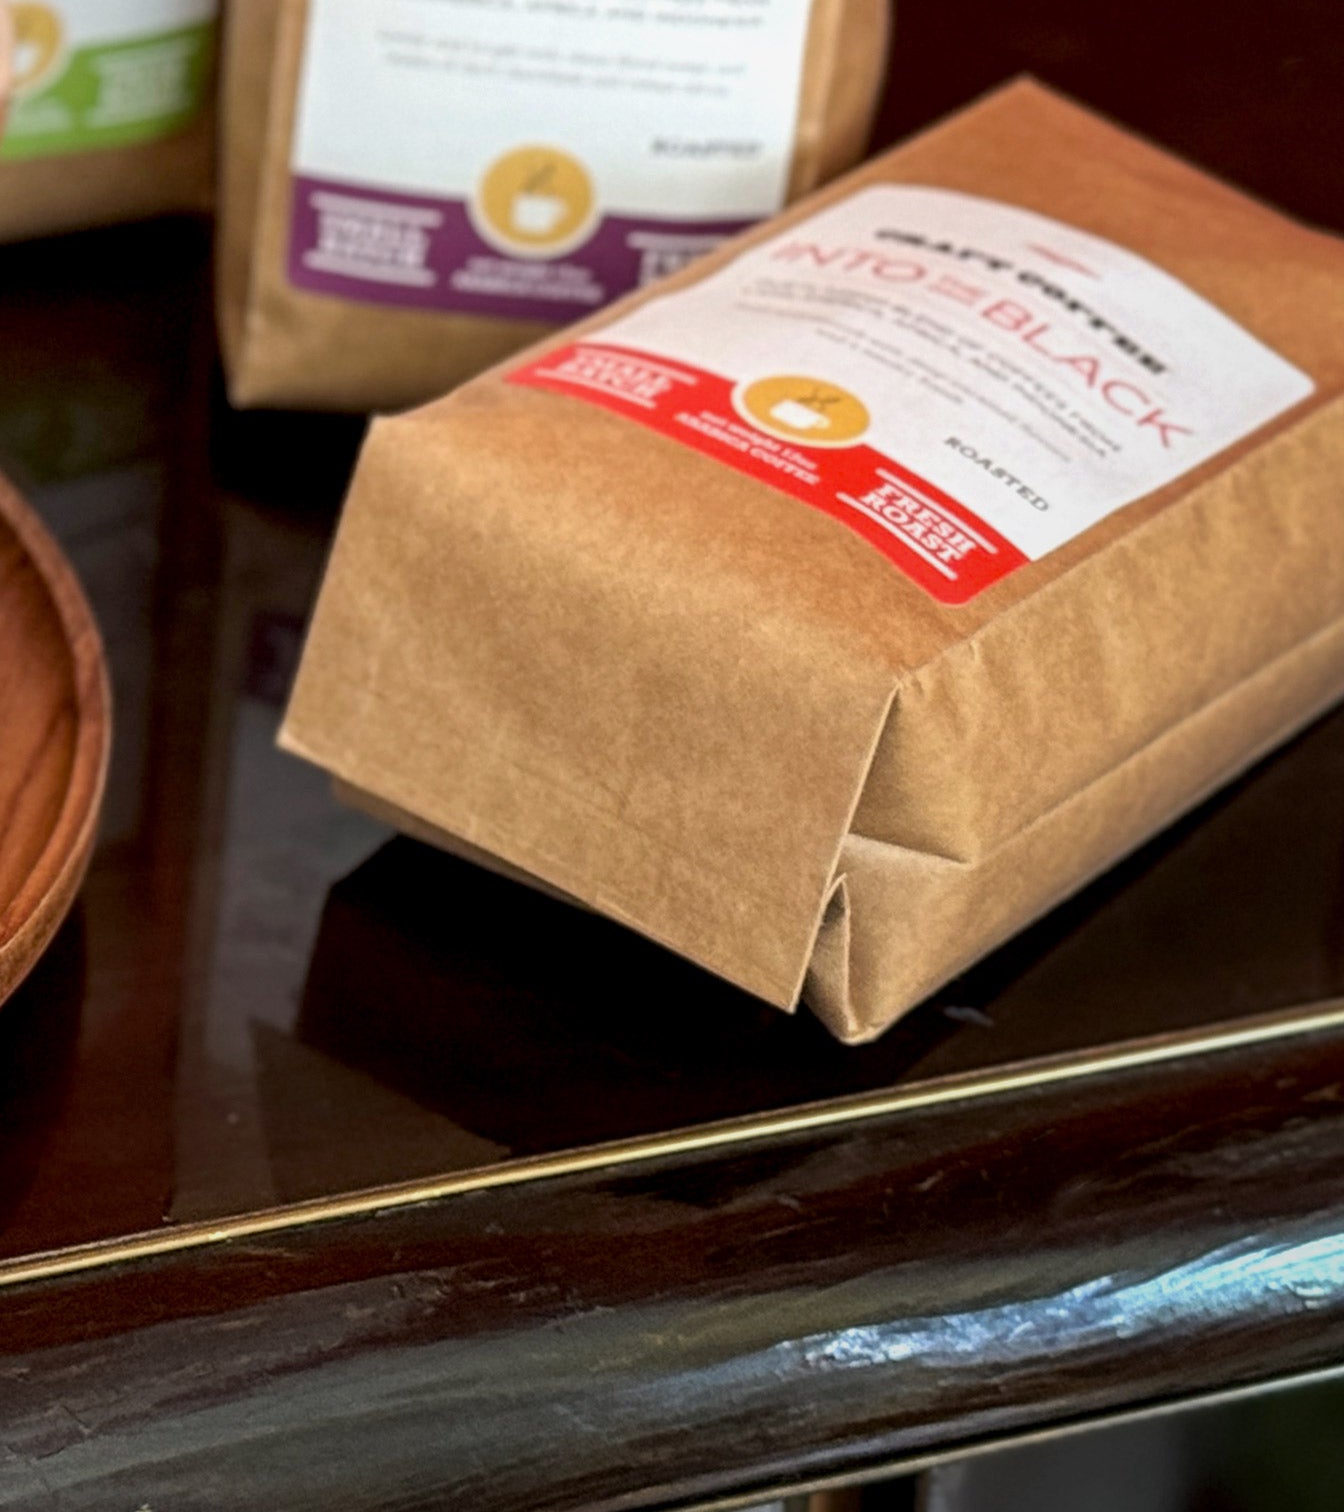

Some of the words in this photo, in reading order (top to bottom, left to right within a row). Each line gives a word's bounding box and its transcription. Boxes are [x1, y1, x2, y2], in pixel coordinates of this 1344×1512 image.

[980, 299, 1194, 449] BLACK
[944, 435, 1050, 513] ROASTED
[859, 491, 963, 562] ROAST
[876, 483, 977, 553] FRESH
